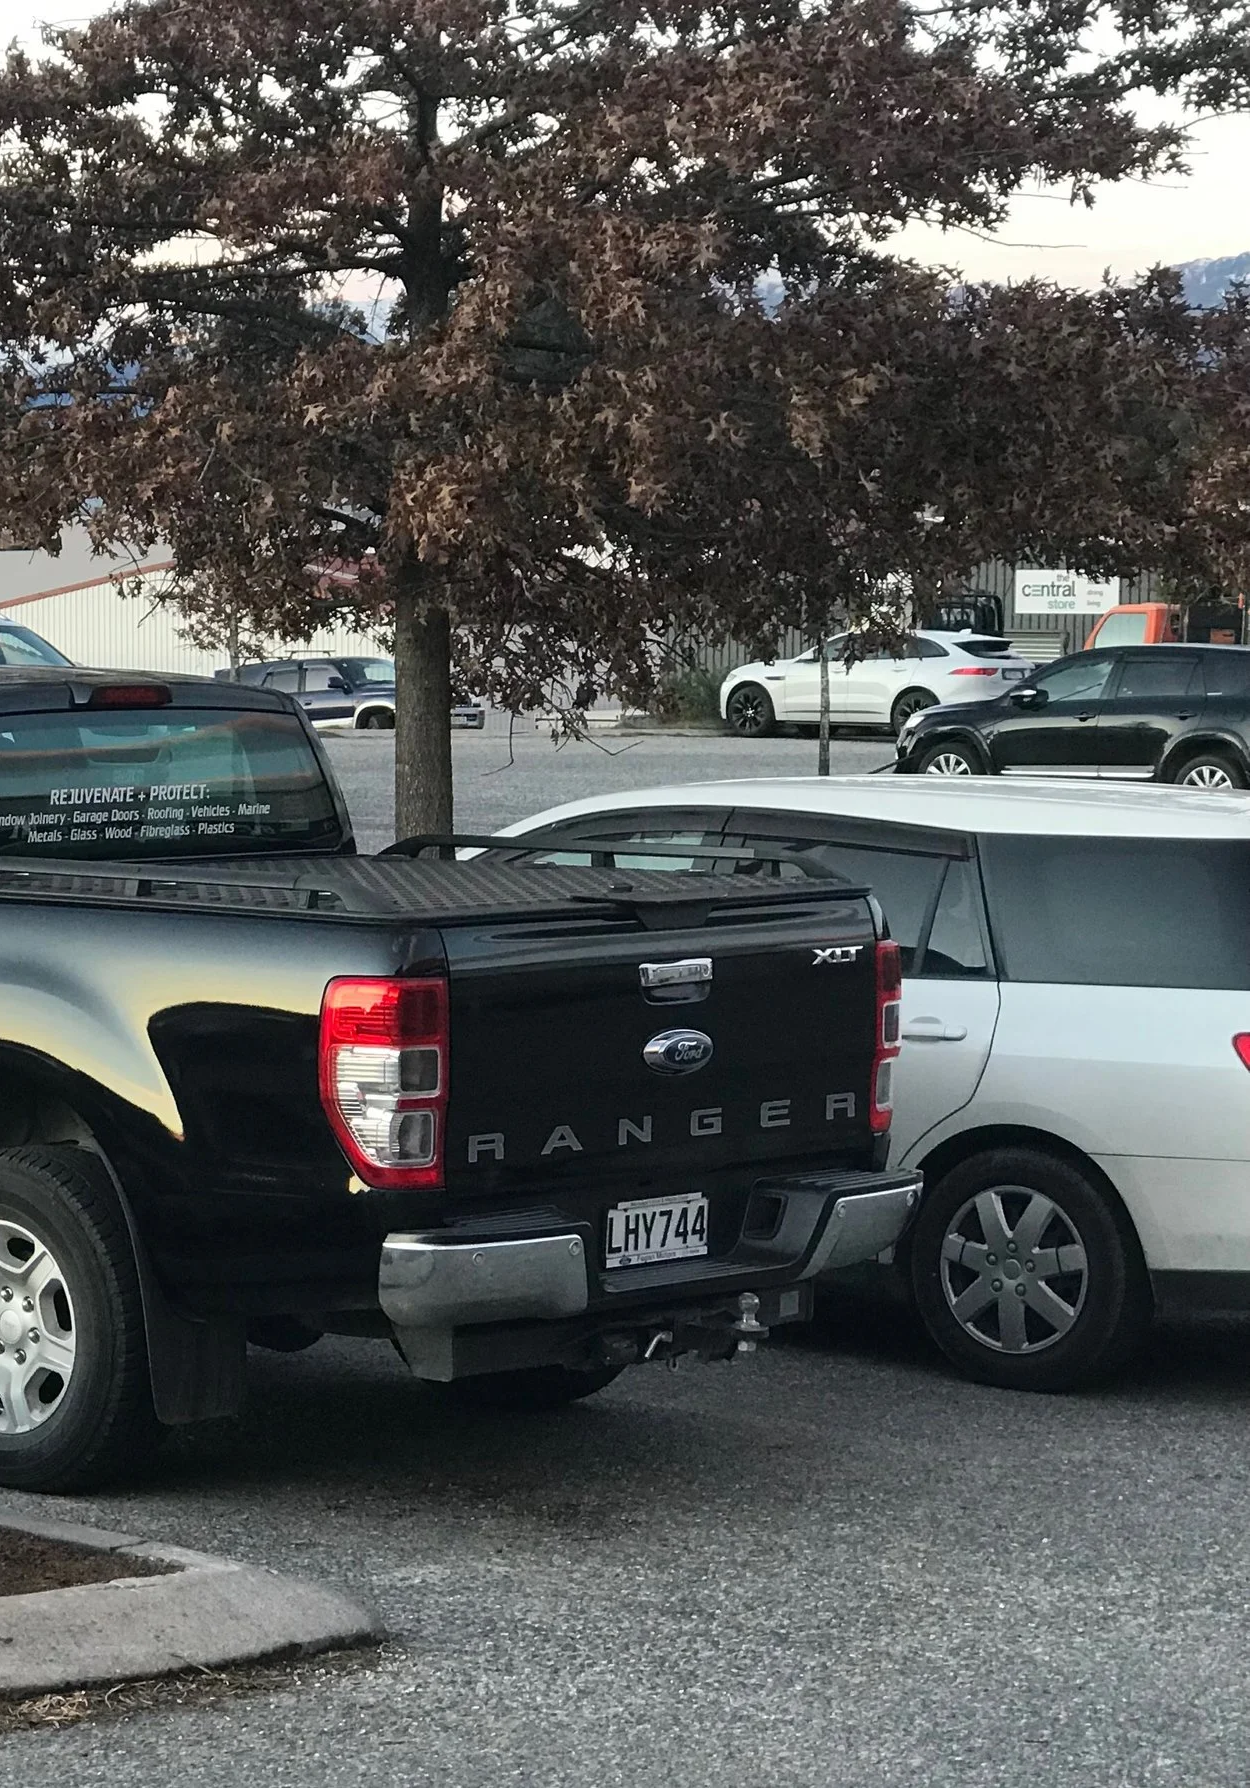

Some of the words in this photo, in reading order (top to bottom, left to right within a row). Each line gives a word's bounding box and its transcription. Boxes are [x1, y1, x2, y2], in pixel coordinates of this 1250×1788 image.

[1056, 573, 1070, 582] the
[1021, 580, 1076, 597] central
[1047, 599, 1076, 609] store
[50, 786, 135, 805] REJUVENATE
[150, 784, 210, 801] PROTECT:
[28, 812, 67, 826] Joinery
[73, 810, 109, 824] Garage
[111, 808, 140, 821] Doors
[147, 806, 184, 820] Roofing
[191, 804, 230, 818] Vehicles
[237, 803, 271, 816] Marine
[27, 829, 63, 843] Metals
[70, 828, 98, 841] Glass
[105, 826, 133, 840] Wood
[140, 823, 190, 839] Fibreglass
[197, 822, 235, 835] Plastics
[812, 945, 864, 966] XLT
[674, 1040, 705, 1062] Ford
[467, 1091, 857, 1164] RANGER
[607, 1205, 706, 1255] LHY744
